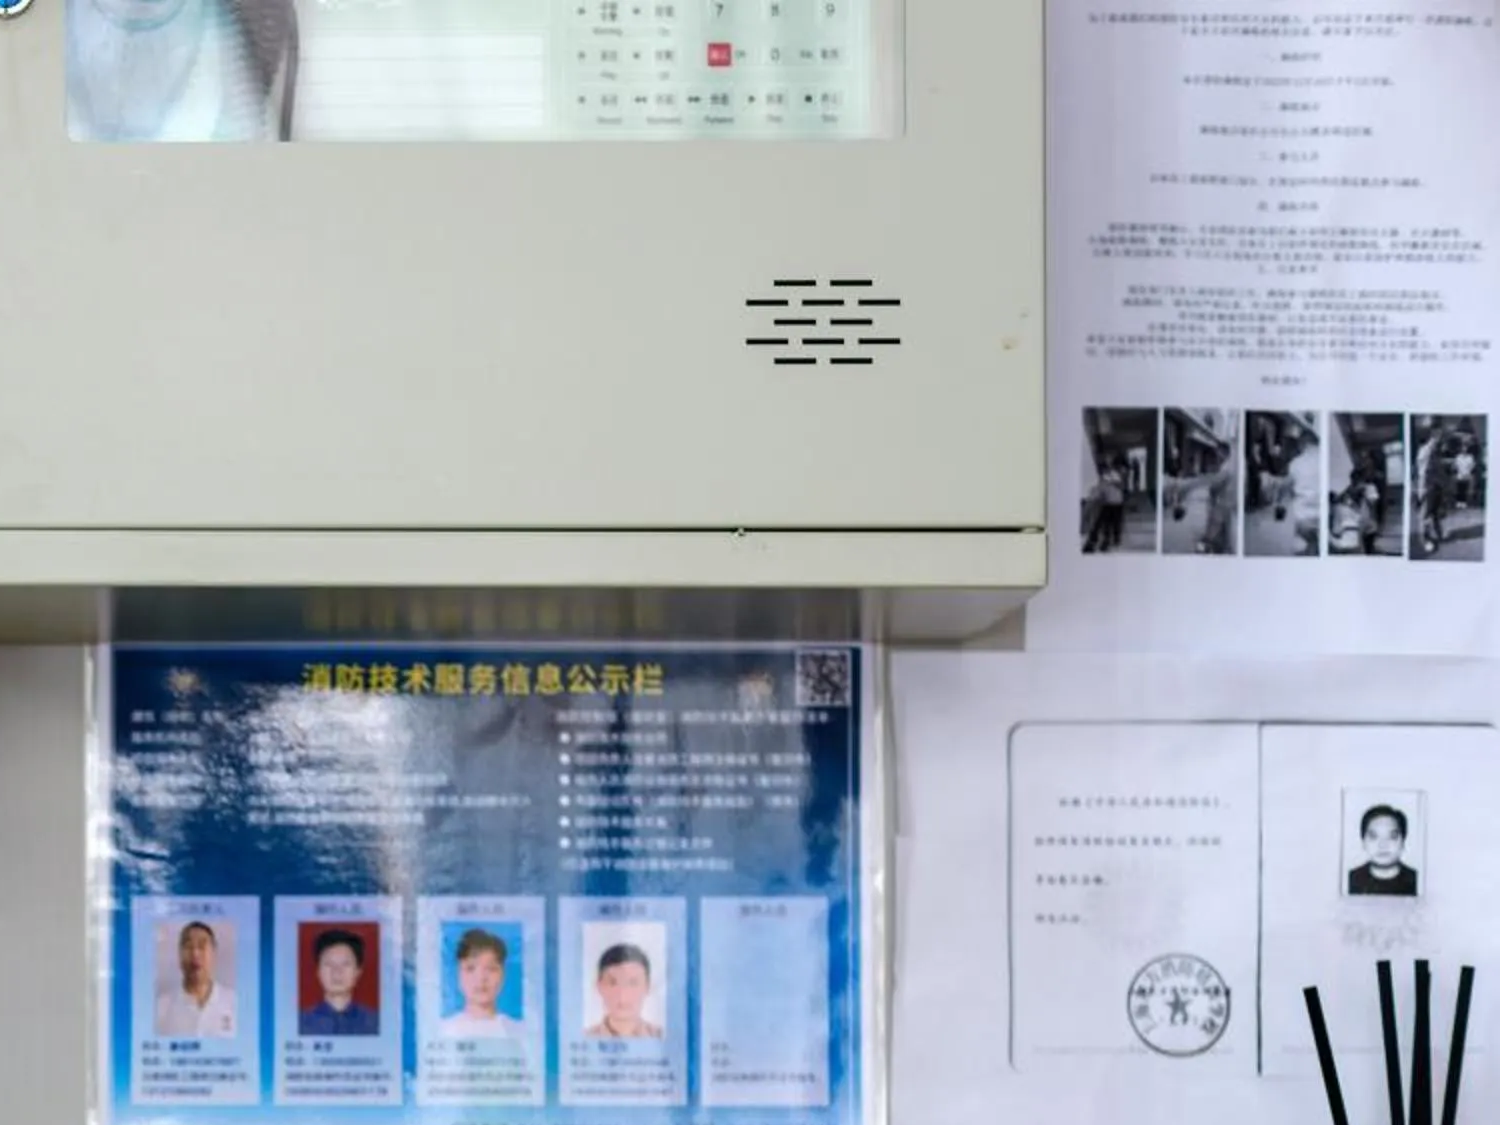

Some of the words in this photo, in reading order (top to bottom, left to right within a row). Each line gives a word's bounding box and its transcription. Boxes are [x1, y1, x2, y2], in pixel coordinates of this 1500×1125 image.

[715, 3, 724, 18] 7
[302, 662, 664, 696] 消防技术服务信息公示栏
